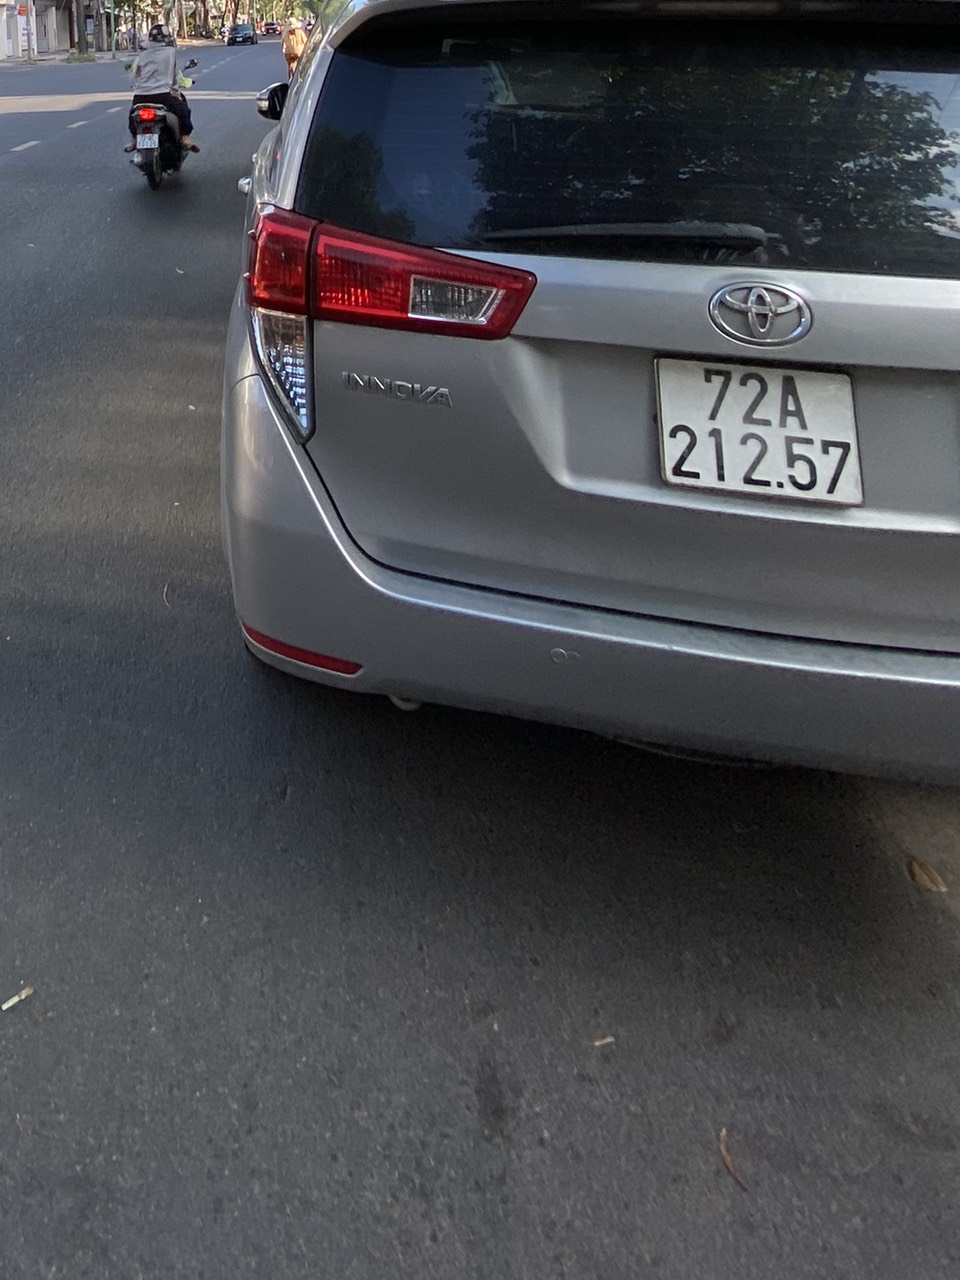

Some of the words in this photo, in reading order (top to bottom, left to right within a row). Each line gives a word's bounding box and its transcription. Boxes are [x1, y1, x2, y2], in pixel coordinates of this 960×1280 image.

[341, 370, 453, 408] INNOVA
[703, 368, 808, 430] 72A
[667, 424, 852, 495] 212.57
